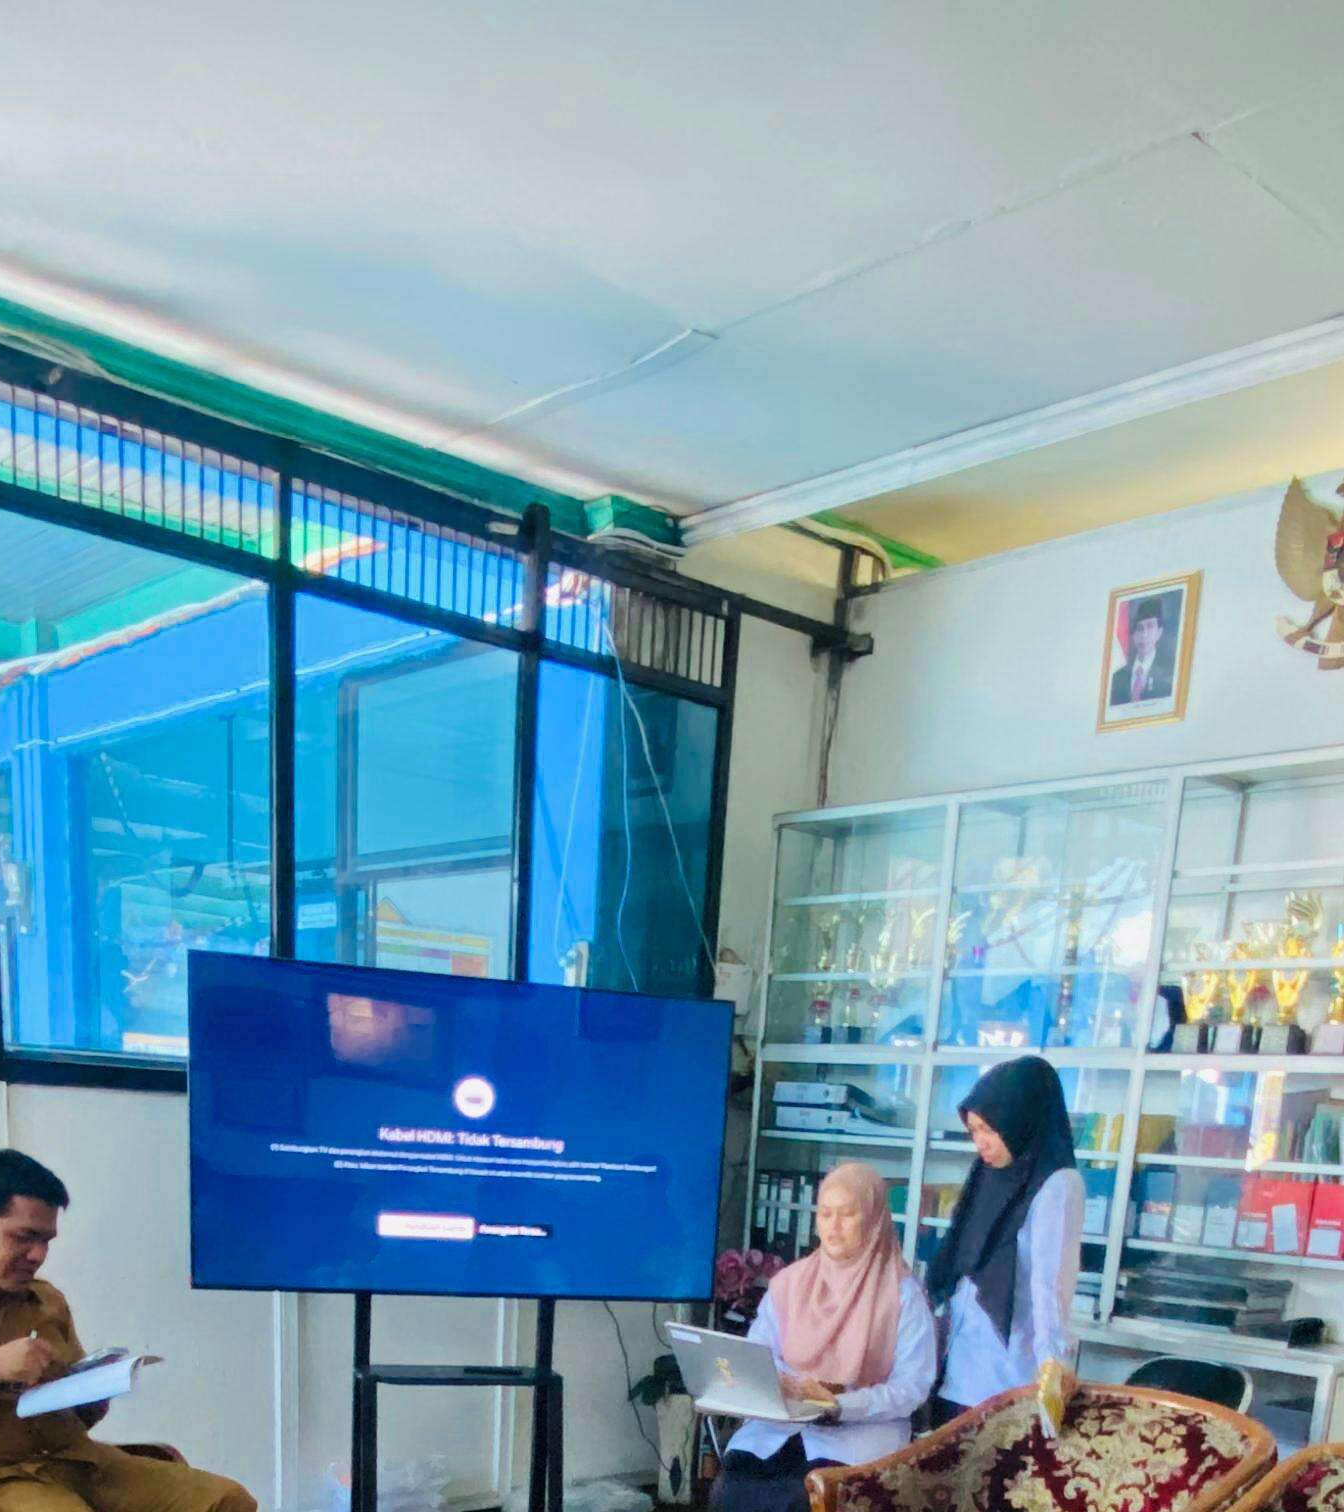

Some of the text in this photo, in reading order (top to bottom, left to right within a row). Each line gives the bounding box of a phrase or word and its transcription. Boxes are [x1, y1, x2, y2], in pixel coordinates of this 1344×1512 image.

[378, 1126, 415, 1142] Kabel
[457, 1131, 490, 1147] Tidak
[492, 1133, 565, 1154] Tersambung
